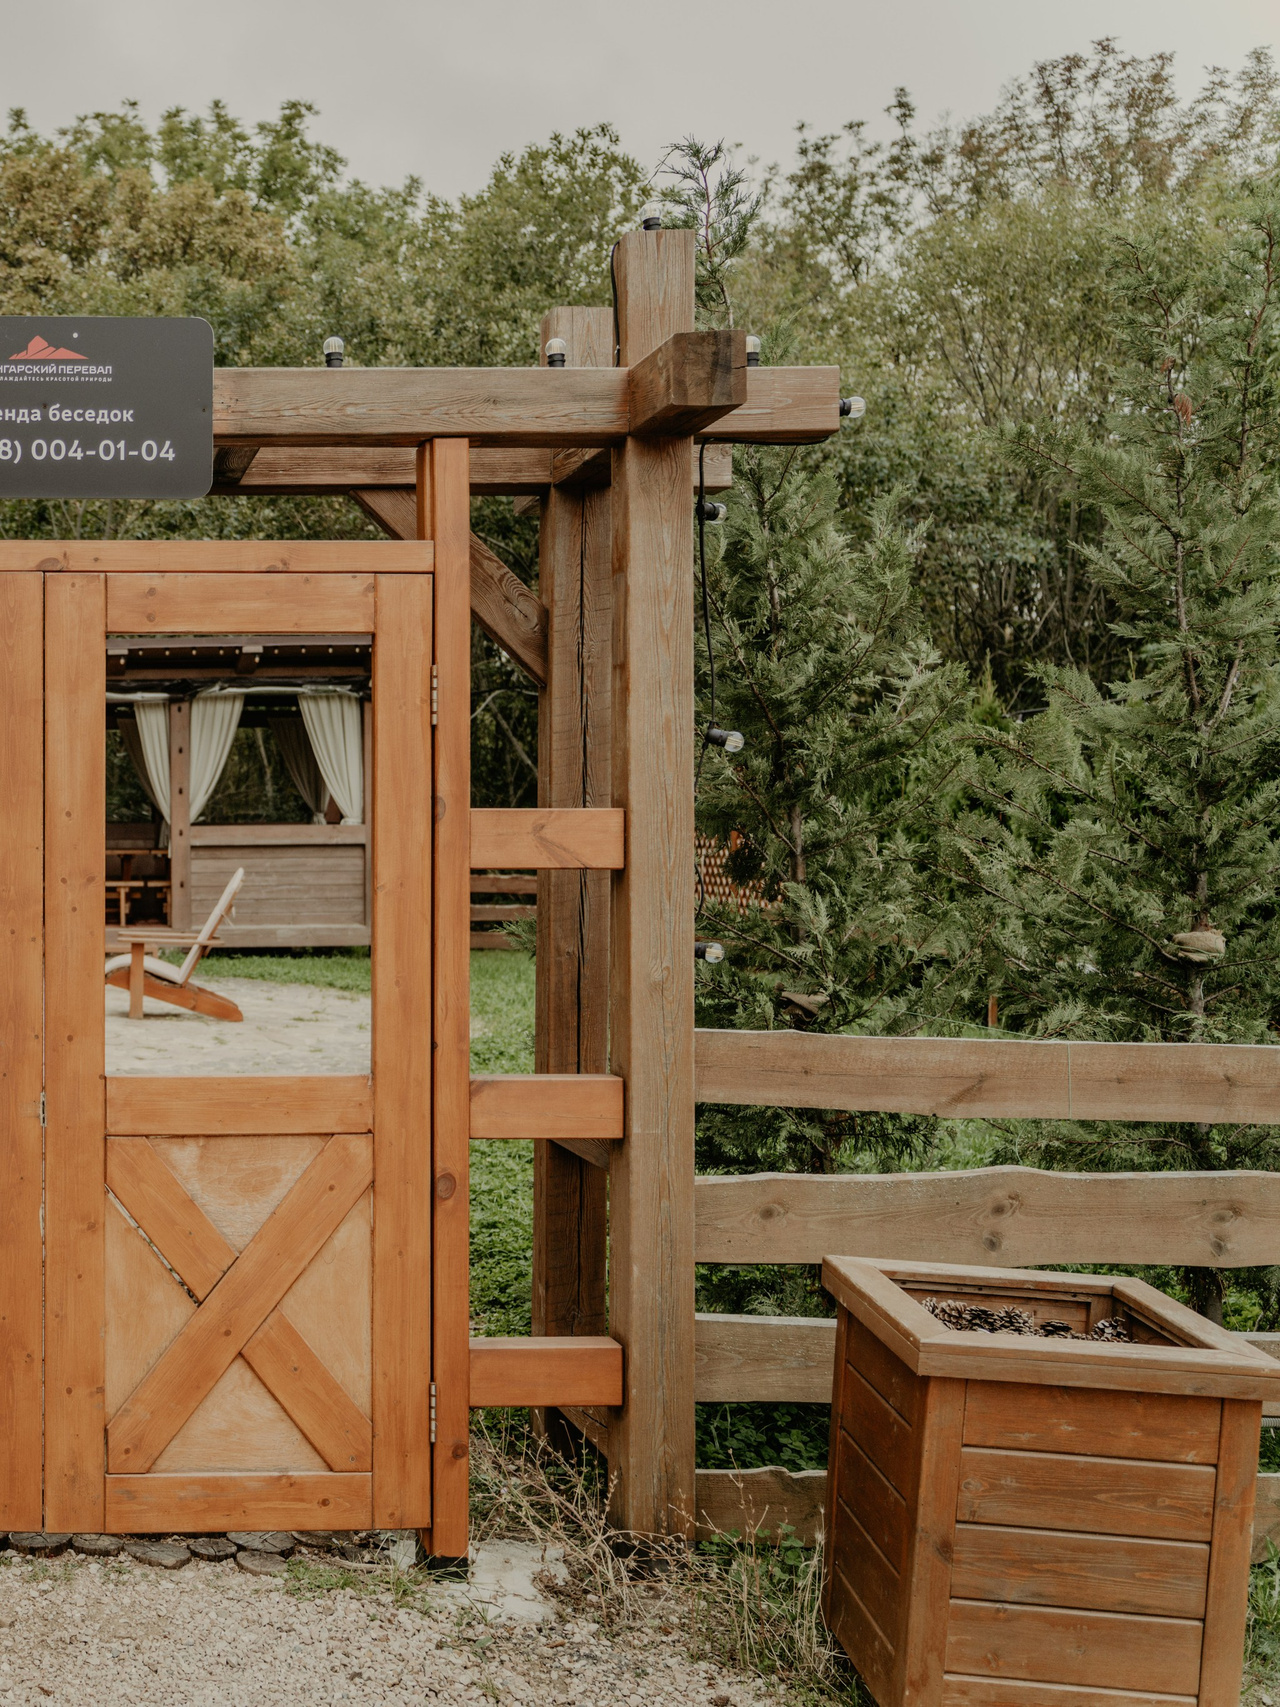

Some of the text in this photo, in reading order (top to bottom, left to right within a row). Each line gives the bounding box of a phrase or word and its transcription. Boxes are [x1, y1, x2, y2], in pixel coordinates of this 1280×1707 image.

[58, 366, 112, 374] ПЕРЕВАЛ
[48, 403, 134, 425] беседок
[30, 439, 176, 461] 004-01-04
